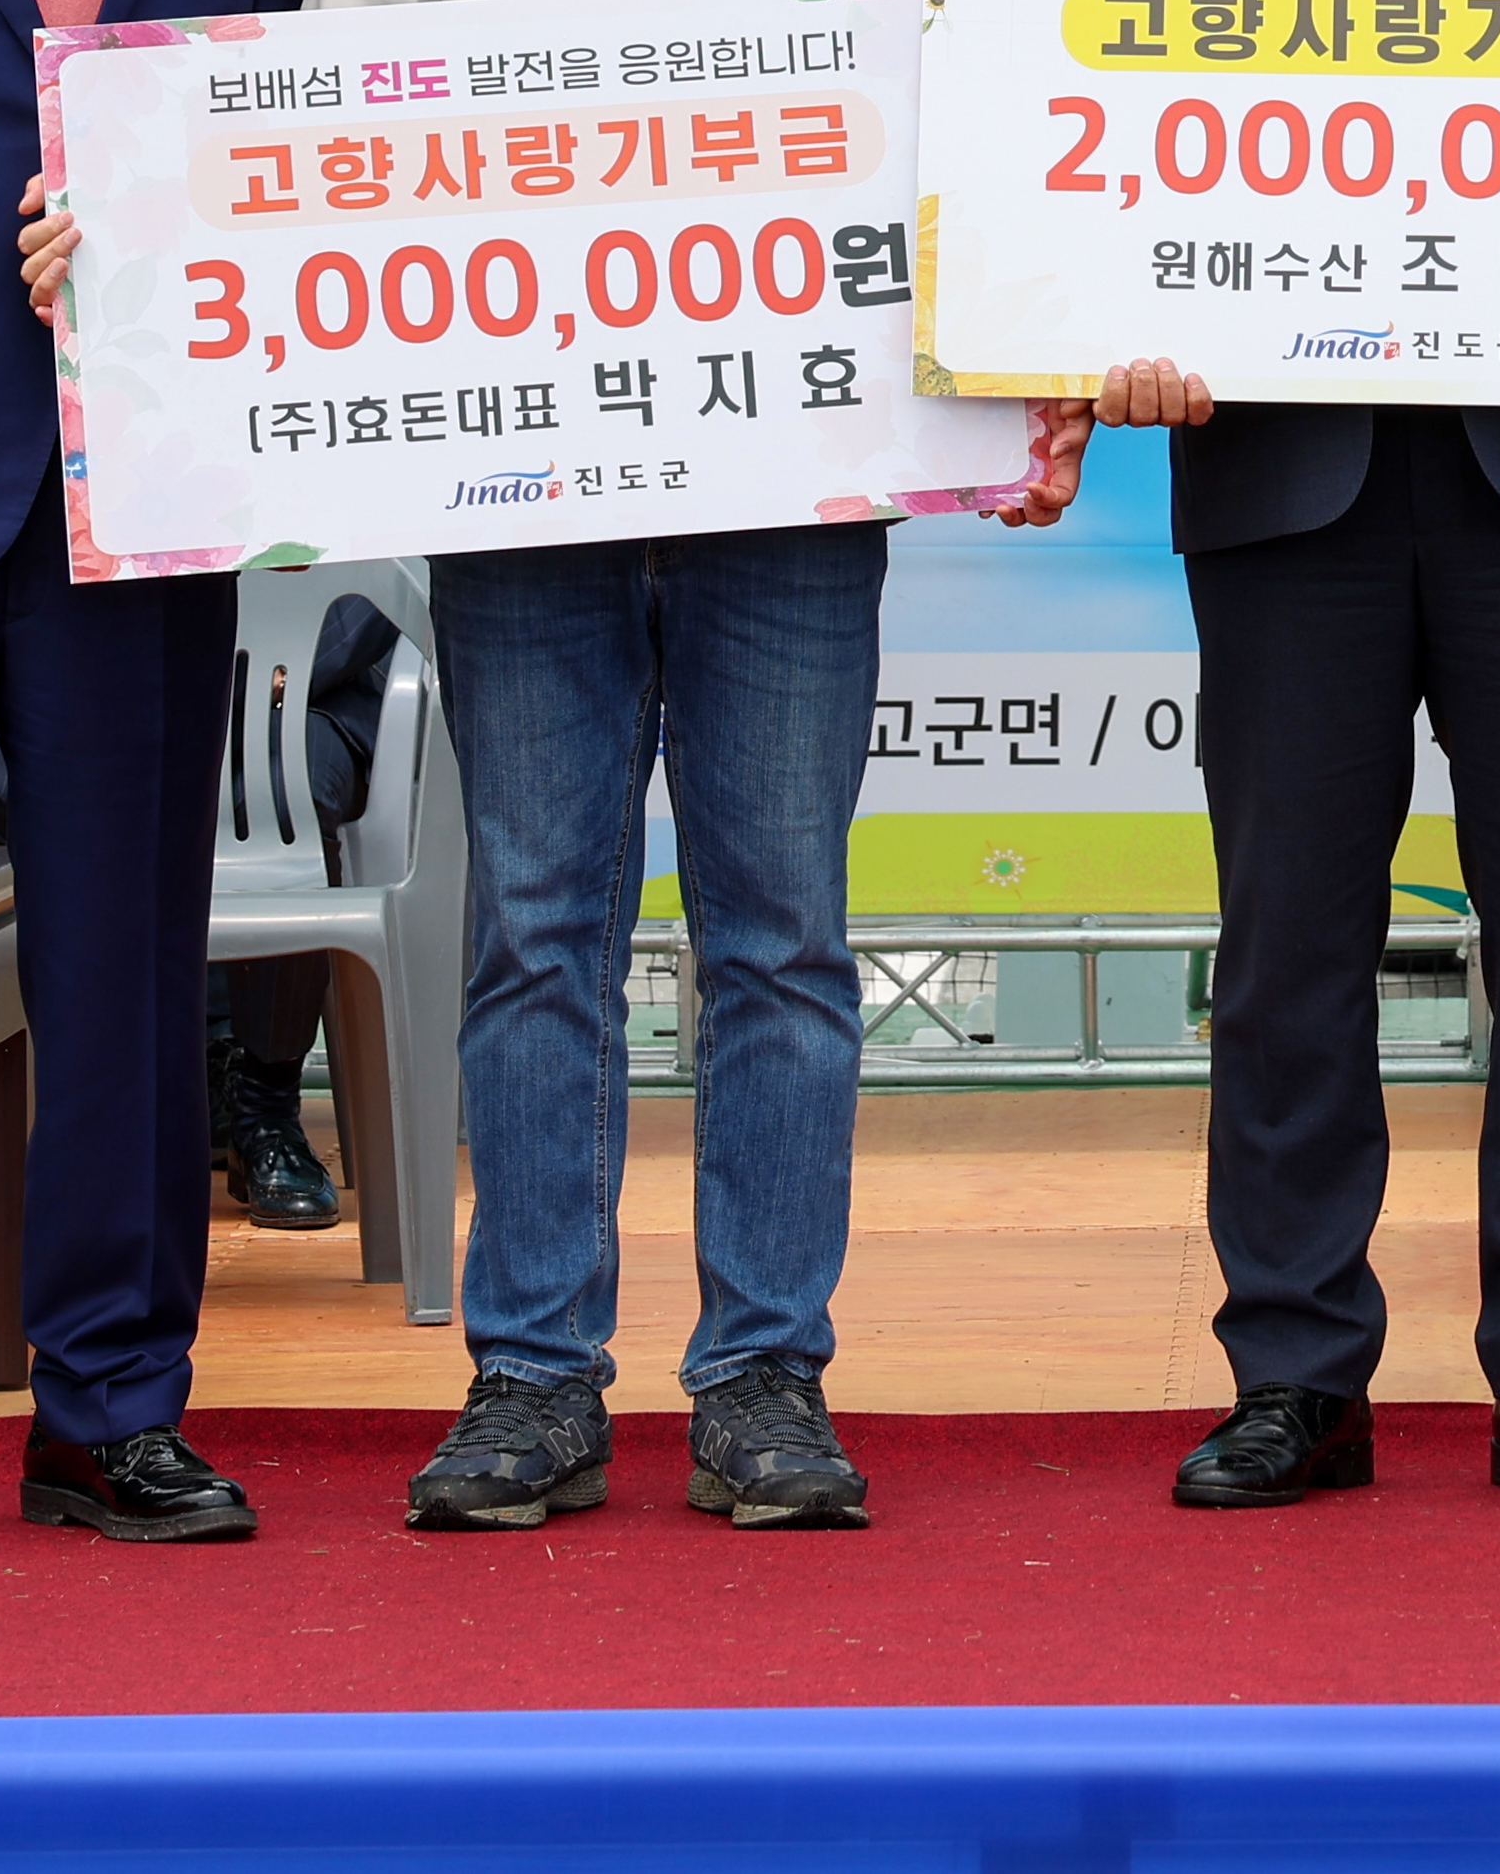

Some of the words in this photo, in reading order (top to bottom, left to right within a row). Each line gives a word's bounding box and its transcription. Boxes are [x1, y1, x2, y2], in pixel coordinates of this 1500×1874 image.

[210, 66, 341, 113] 보배섬
[362, 59, 450, 103] 진도
[468, 48, 600, 96] 발전을
[619, 31, 855, 85] 응원합니다!
[229, 104, 848, 215] 고향사랑기부금
[185, 218, 911, 373] 3,000,000원
[1152, 241, 1367, 292] 원해수산
[249, 383, 559, 453] (주)효돈대표
